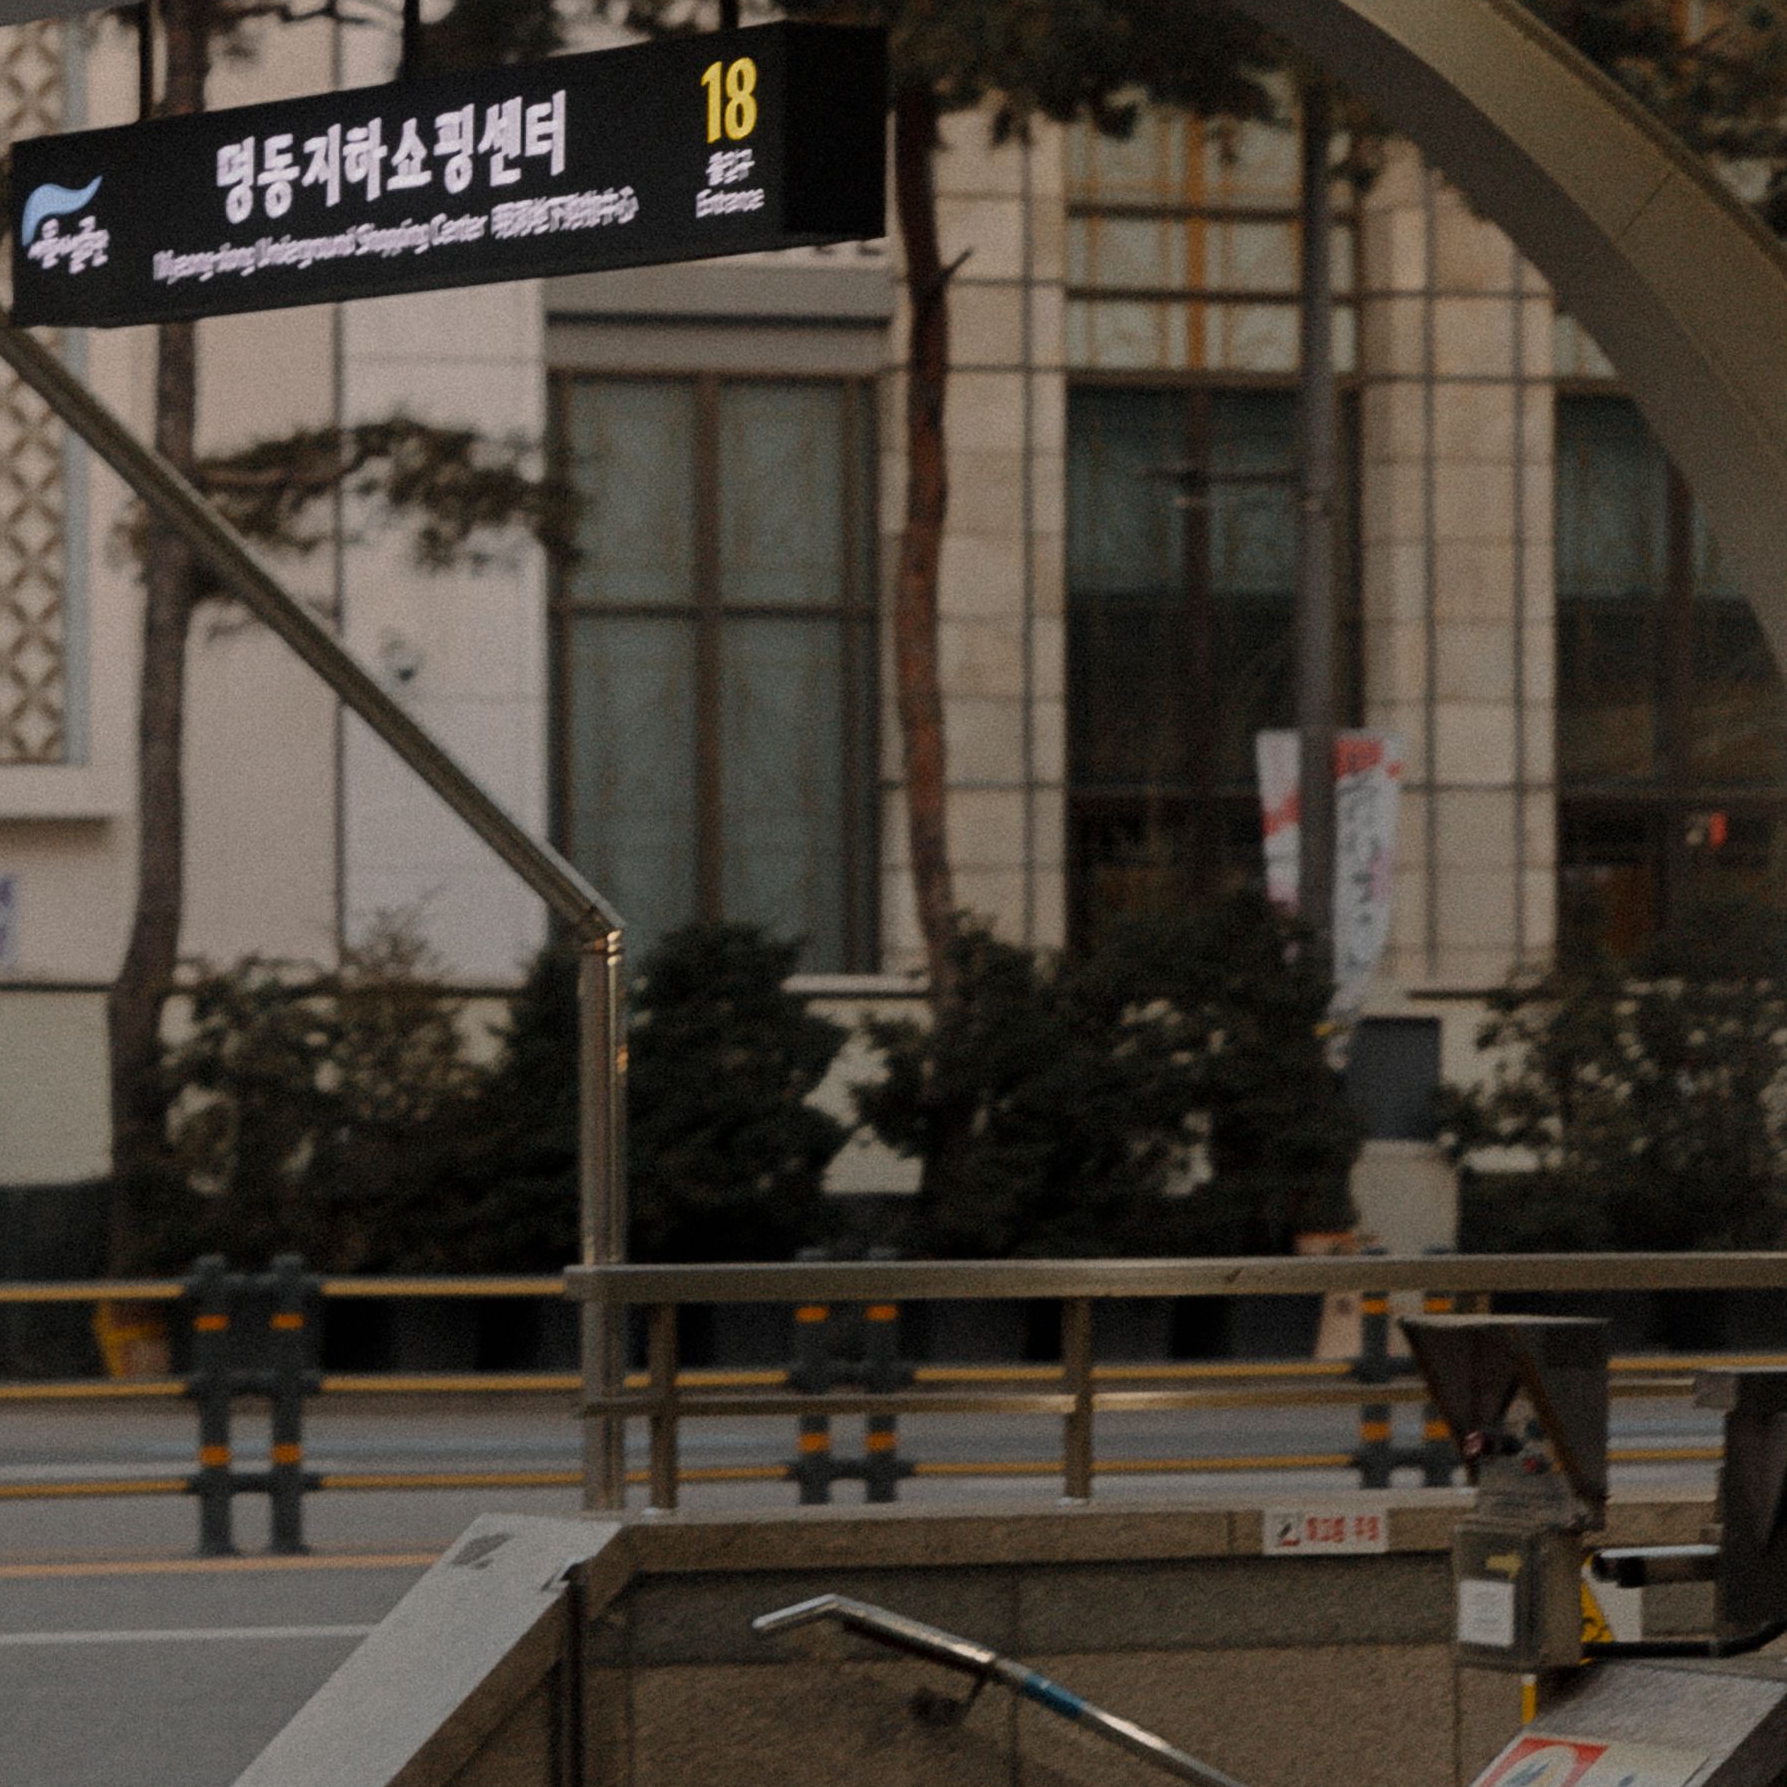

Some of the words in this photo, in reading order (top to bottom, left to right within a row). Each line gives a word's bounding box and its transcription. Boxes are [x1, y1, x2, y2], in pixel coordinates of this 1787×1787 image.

[701, 57, 758, 144] 18
[216, 89, 566, 225] 명동지하쇼핑센터
[429, 213, 489, 246] Center
